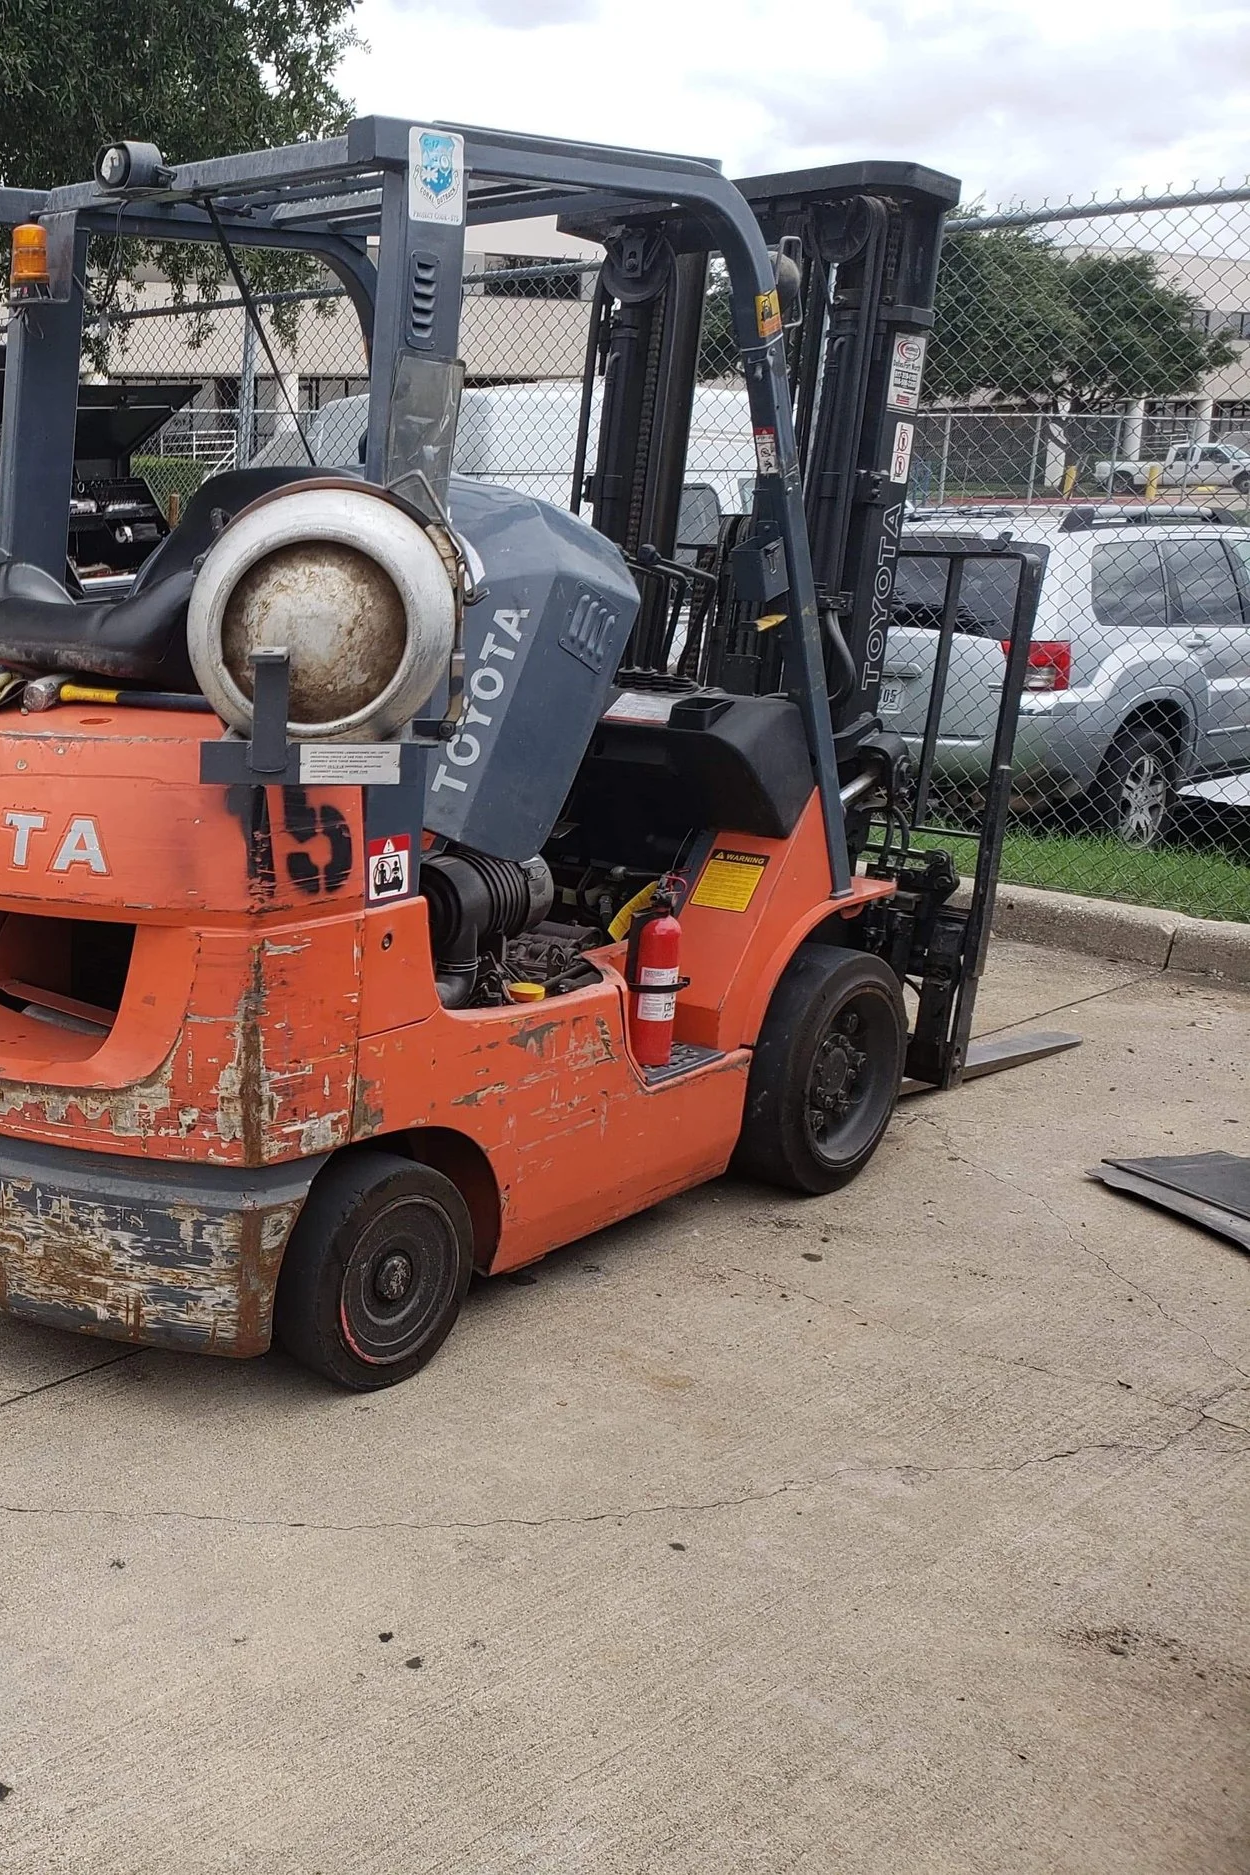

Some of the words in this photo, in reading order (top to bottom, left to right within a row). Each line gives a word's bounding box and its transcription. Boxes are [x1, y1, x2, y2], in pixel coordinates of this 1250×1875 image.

[423, 138, 439, 148] C-17
[861, 503, 901, 690] TOYOTA
[431, 608, 530, 793] TOYOTA
[726, 853, 765, 865] WARNING
